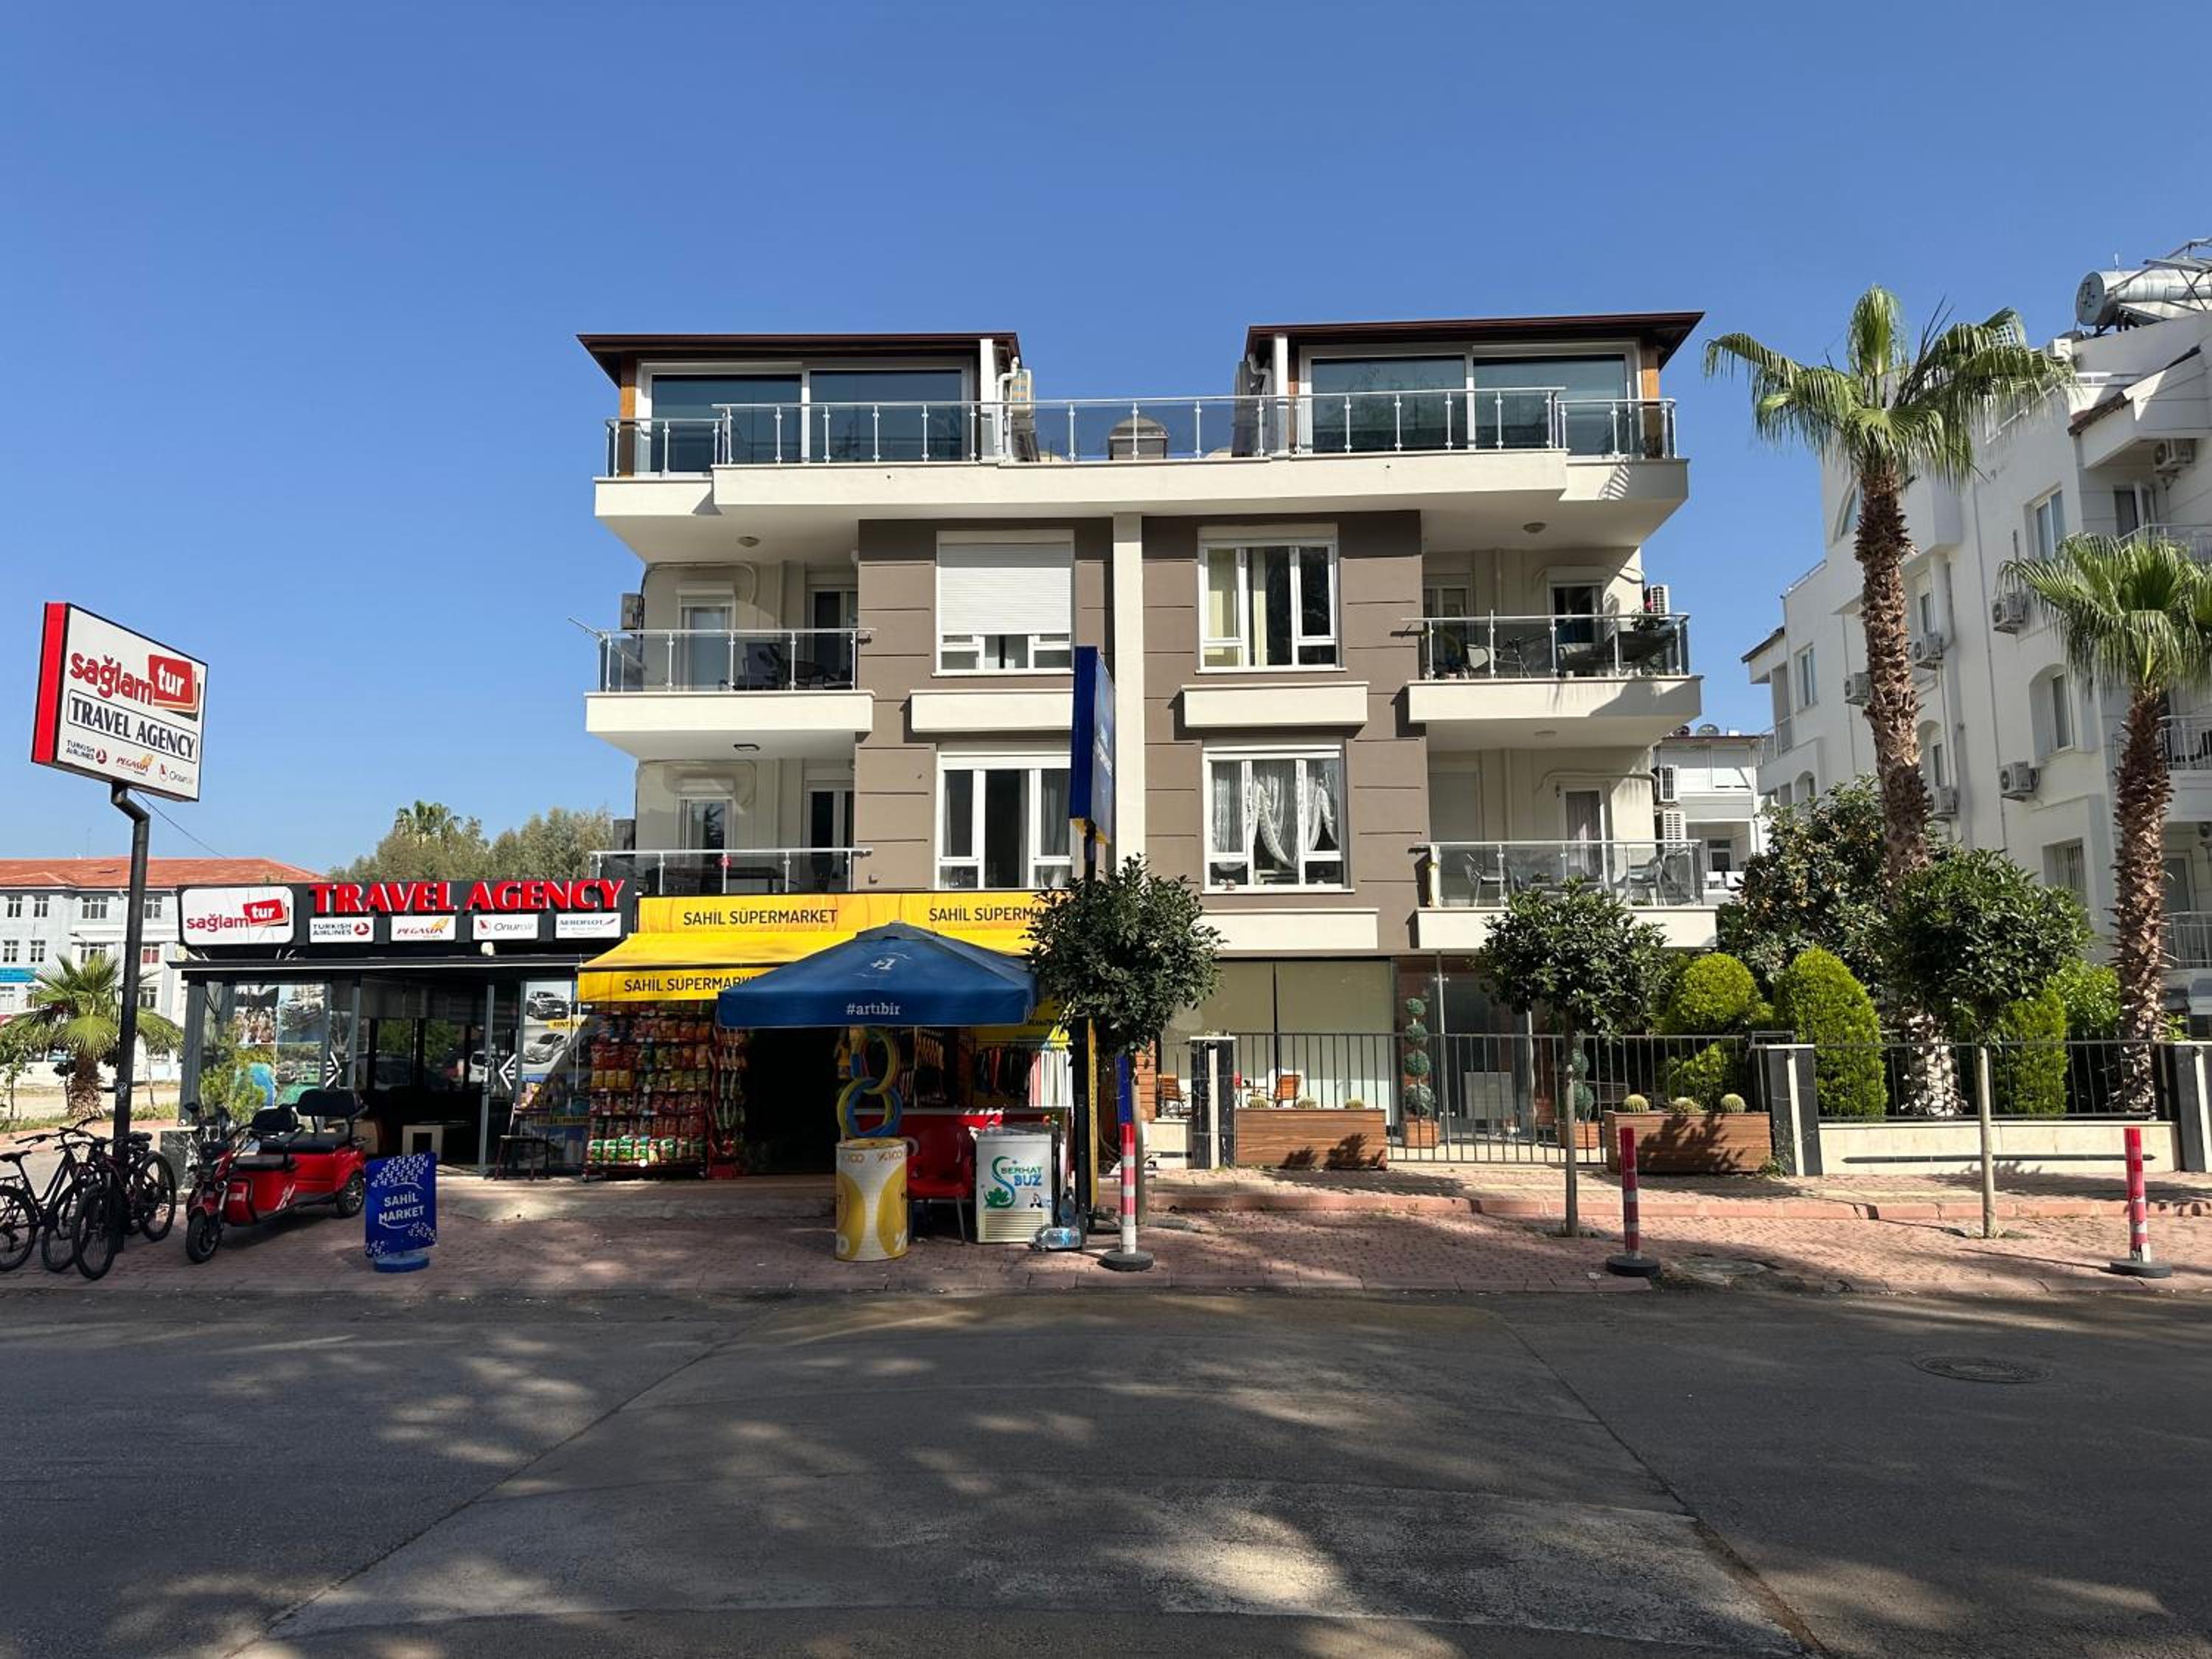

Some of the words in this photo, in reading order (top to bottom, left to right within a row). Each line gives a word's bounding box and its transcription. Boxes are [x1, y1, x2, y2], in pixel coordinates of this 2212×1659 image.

[70, 653, 153, 706] sağlam
[157, 663, 185, 697] tur
[71, 696, 131, 738] TRAVEL
[136, 719, 196, 759] AGENCY
[310, 882, 458, 914] TRAVEL
[464, 879, 625, 912] AGENCY
[186, 912, 249, 933] sağlam
[251, 904, 275, 919] tur
[683, 908, 726, 926] SAHİL
[729, 907, 838, 925] SÜPERMARKET
[929, 904, 971, 922] SAHİL
[625, 975, 664, 992] SAHİL
[1014, 1175, 1043, 1186] BUZ
[384, 1191, 420, 1207] SAHİL
[379, 1206, 425, 1223] MARKET
